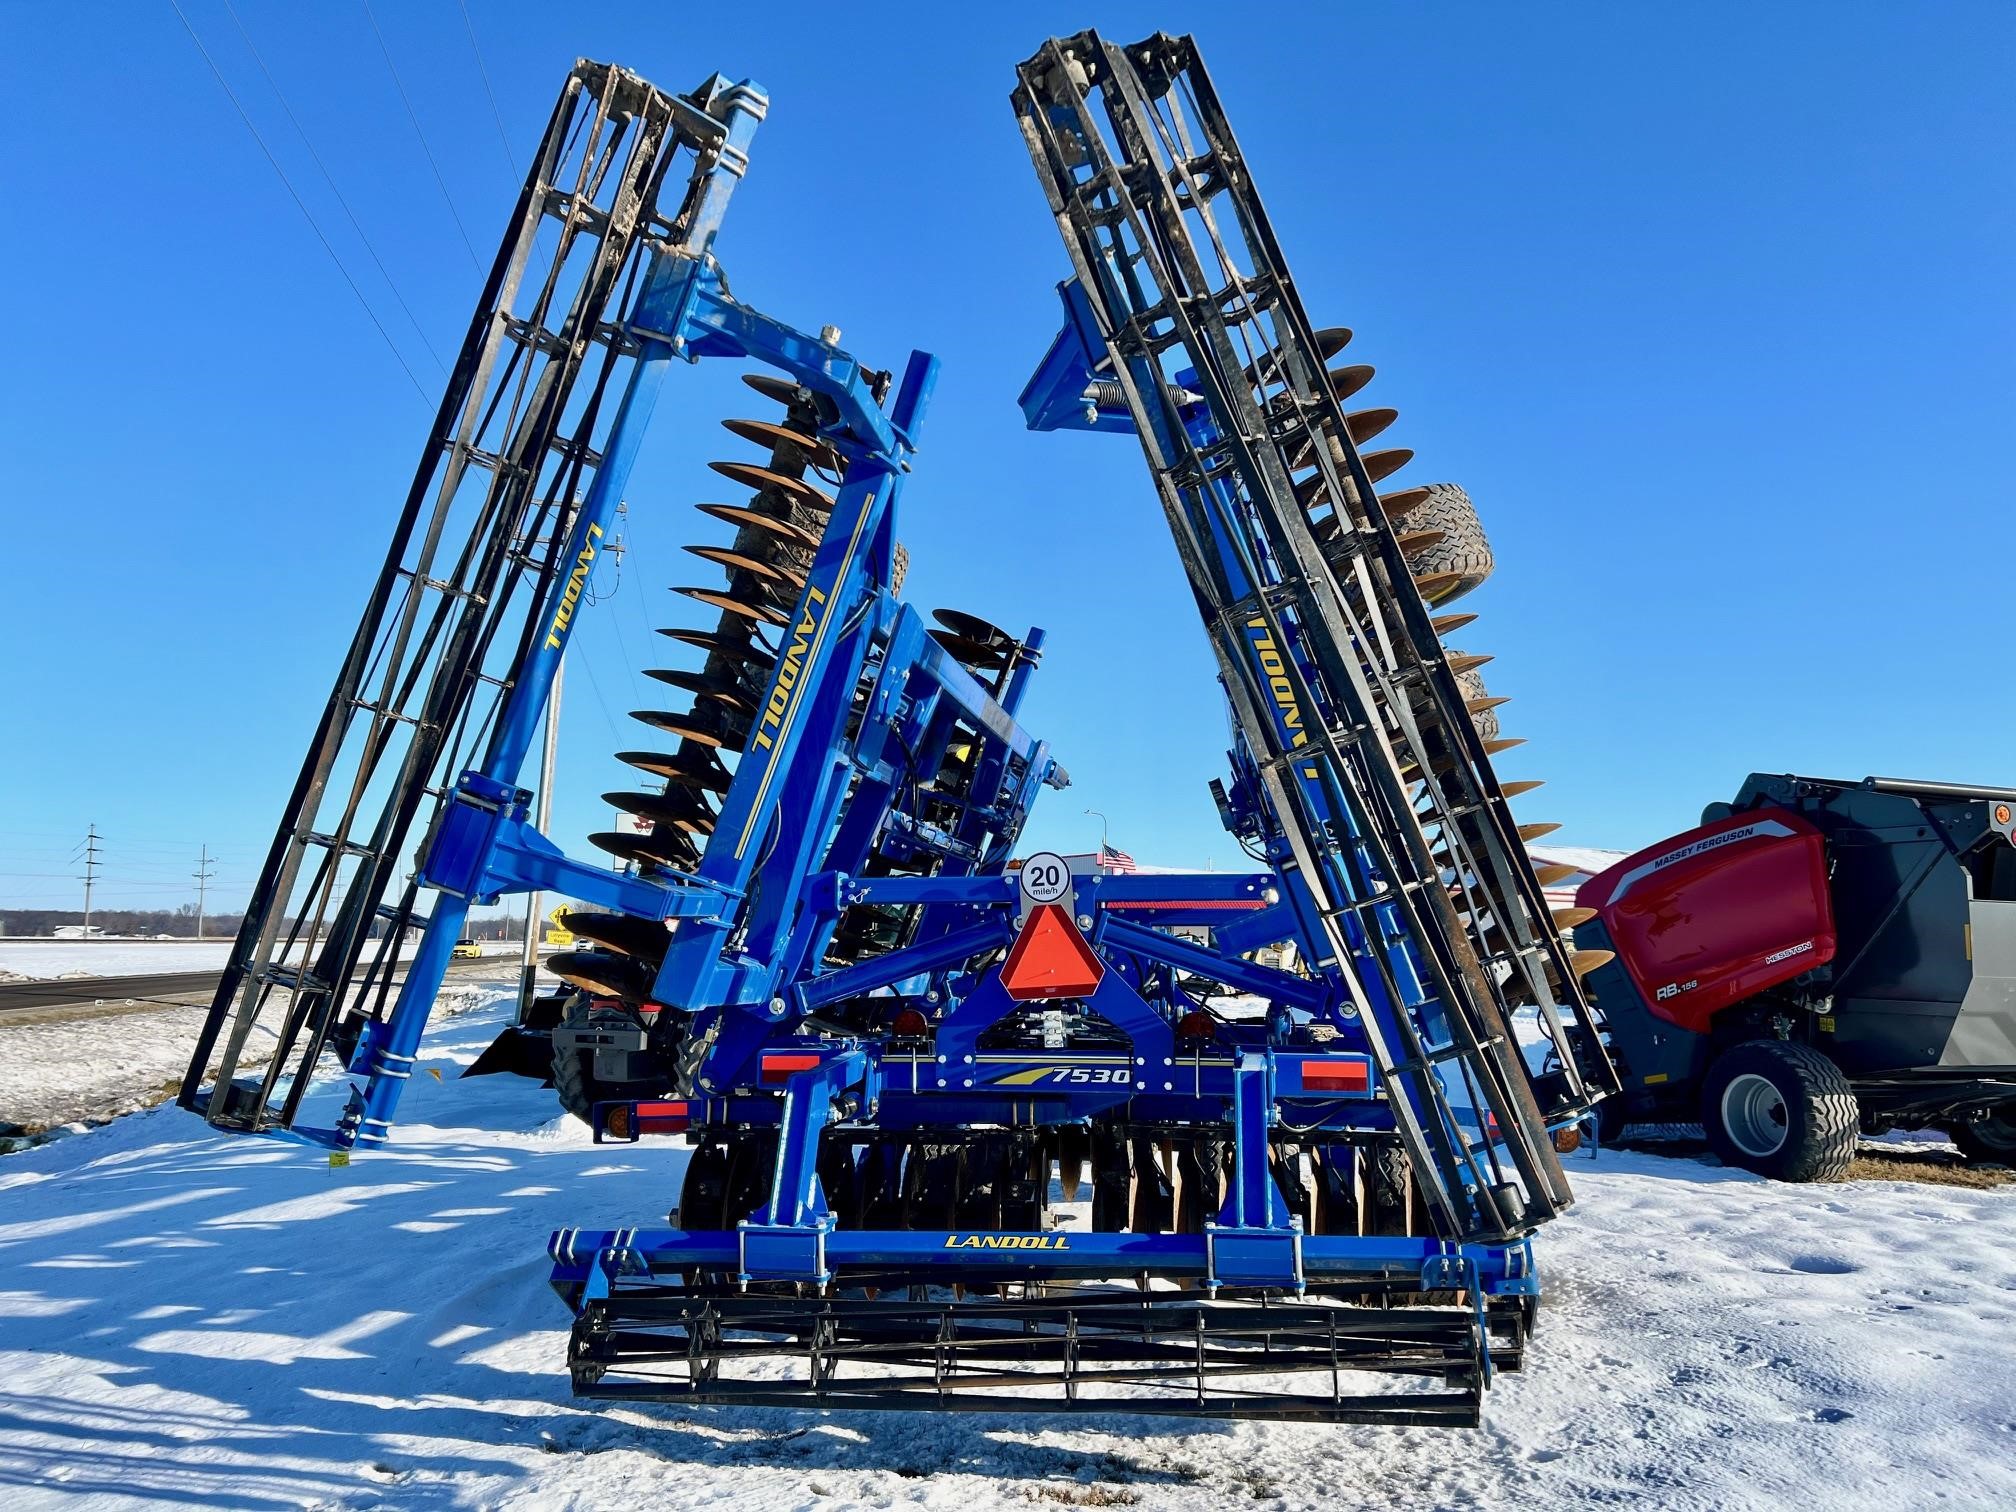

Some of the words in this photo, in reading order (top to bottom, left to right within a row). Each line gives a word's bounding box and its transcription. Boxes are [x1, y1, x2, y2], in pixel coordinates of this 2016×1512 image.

[544, 522, 603, 651] LANDOLL
[752, 585, 826, 752] LANDOLL
[1654, 847, 1694, 869] MASSEY
[1696, 827, 1754, 852] FERGUSON
[1030, 865, 1060, 887] 20
[1033, 888, 1058, 896] mile/h
[1765, 939, 1813, 965] HESSTON
[1051, 1068, 1131, 1084] 7530
[944, 1234, 1071, 1250] LANDOLL
